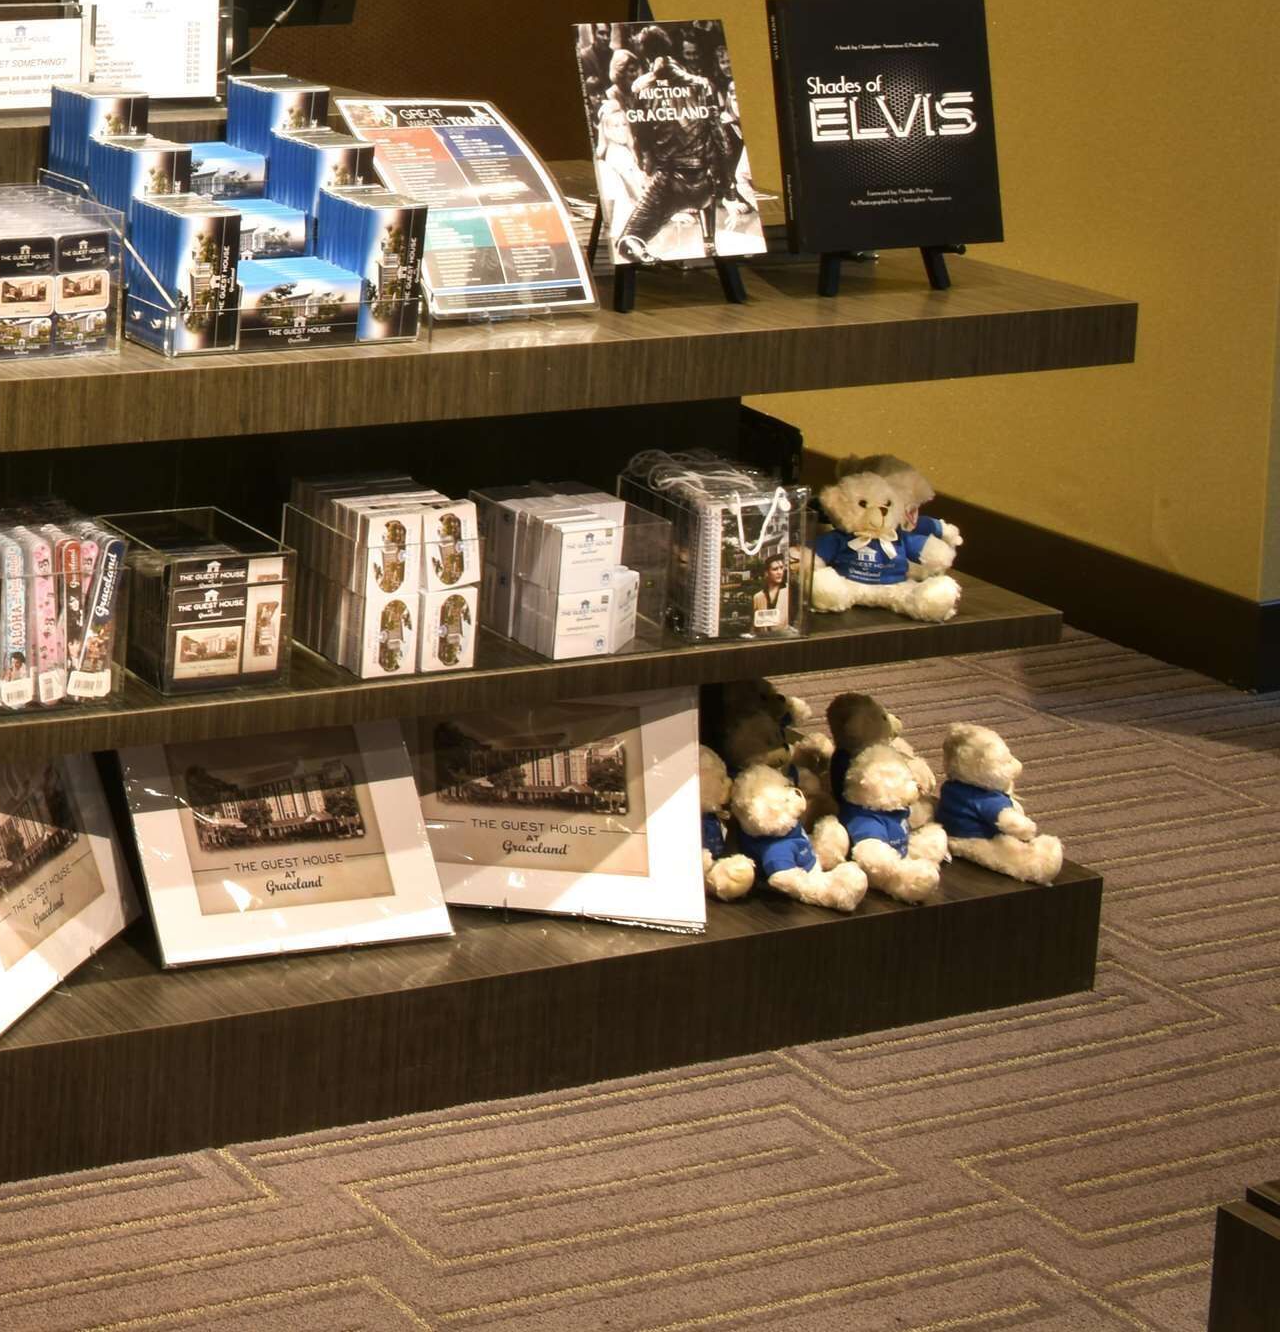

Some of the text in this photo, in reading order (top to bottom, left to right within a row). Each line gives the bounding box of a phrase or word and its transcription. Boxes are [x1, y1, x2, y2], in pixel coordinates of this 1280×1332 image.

[639, 86, 690, 100] AUCTION
[807, 75, 883, 95] Shades of
[400, 108, 443, 121] GREAT
[406, 118, 436, 127] WAYS
[436, 118, 449, 126] TO
[626, 106, 709, 123] GRACELAND
[809, 91, 977, 143] ELVIS
[222, 245, 231, 272] HOUSE
[405, 265, 414, 290] GUEST
[219, 274, 228, 300] GUEST
[268, 326, 332, 336] THE GUEST HOUSE
[95, 552, 117, 617] Graceland
[179, 570, 246, 582] THE GUEST HOUSE
[193, 602, 218, 611] GUEST
[219, 599, 245, 608] HOUSE
[10, 604, 24, 647] ALOHA
[471, 818, 597, 836] THE GUEST HOUSE
[526, 834, 540, 842] AT
[502, 840, 568, 855] Graceland
[234, 853, 344, 872] THE GUEST HOUSE
[12, 863, 72, 915] THE GUEST HOUSE
[266, 875, 323, 895] Graceland
